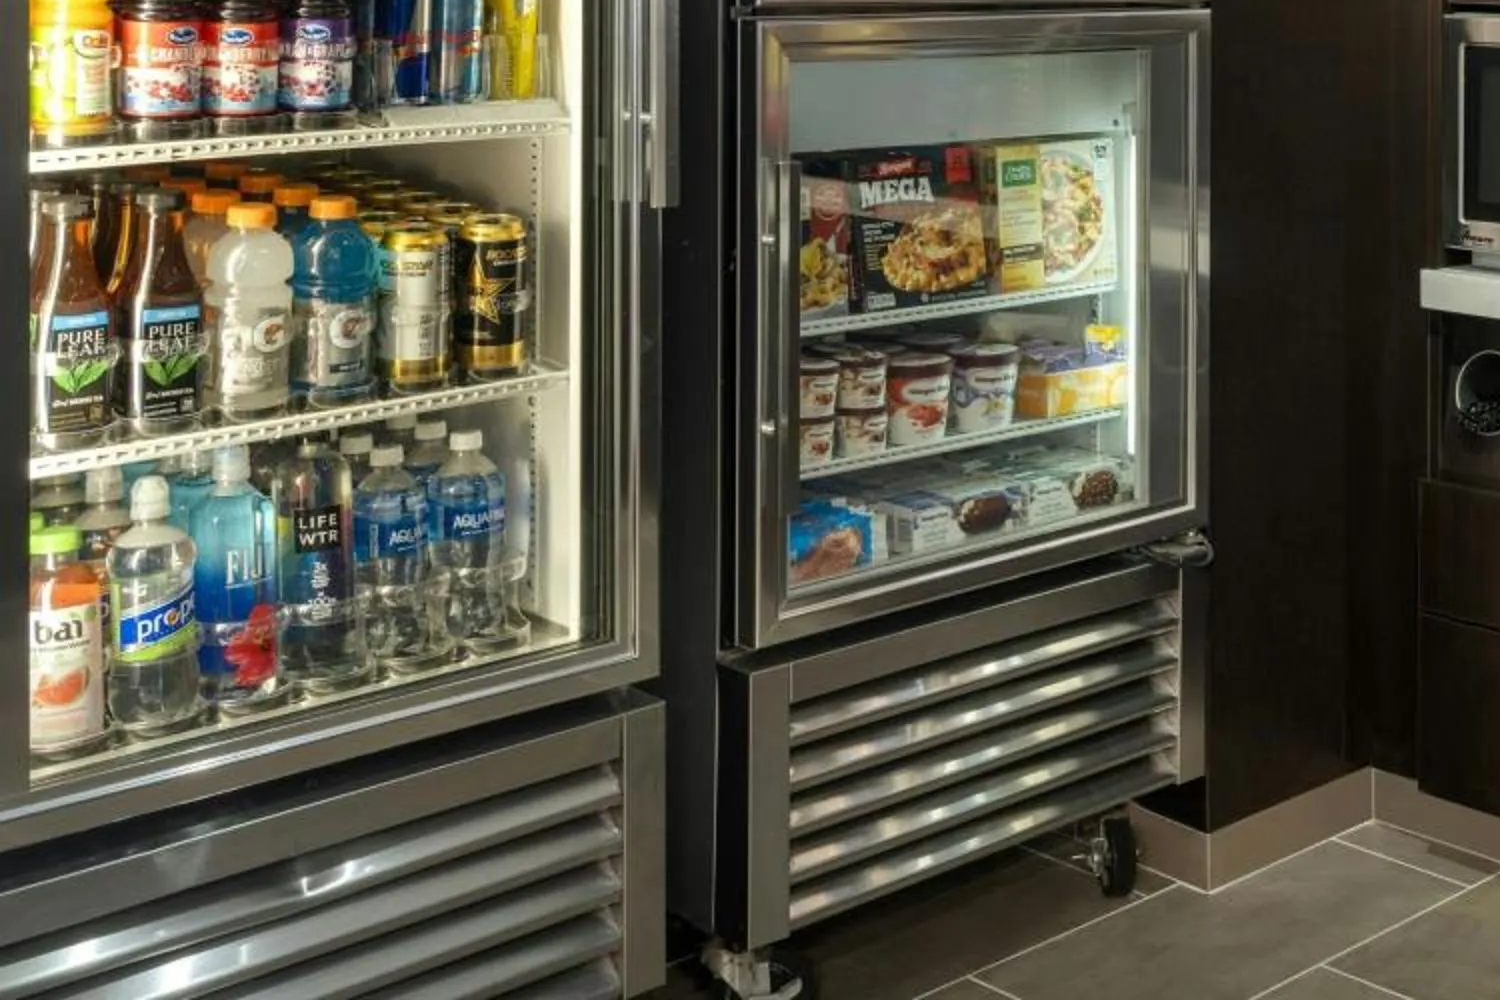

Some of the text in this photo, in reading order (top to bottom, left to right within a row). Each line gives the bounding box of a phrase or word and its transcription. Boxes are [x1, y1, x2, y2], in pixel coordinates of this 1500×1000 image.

[859, 176, 934, 208] MEGA
[57, 328, 105, 346] PURE
[149, 321, 197, 338] PURE
[299, 513, 337, 530] LIFE
[299, 530, 338, 547] WTR
[389, 526, 424, 546] AQUA
[137, 596, 195, 643] prop
